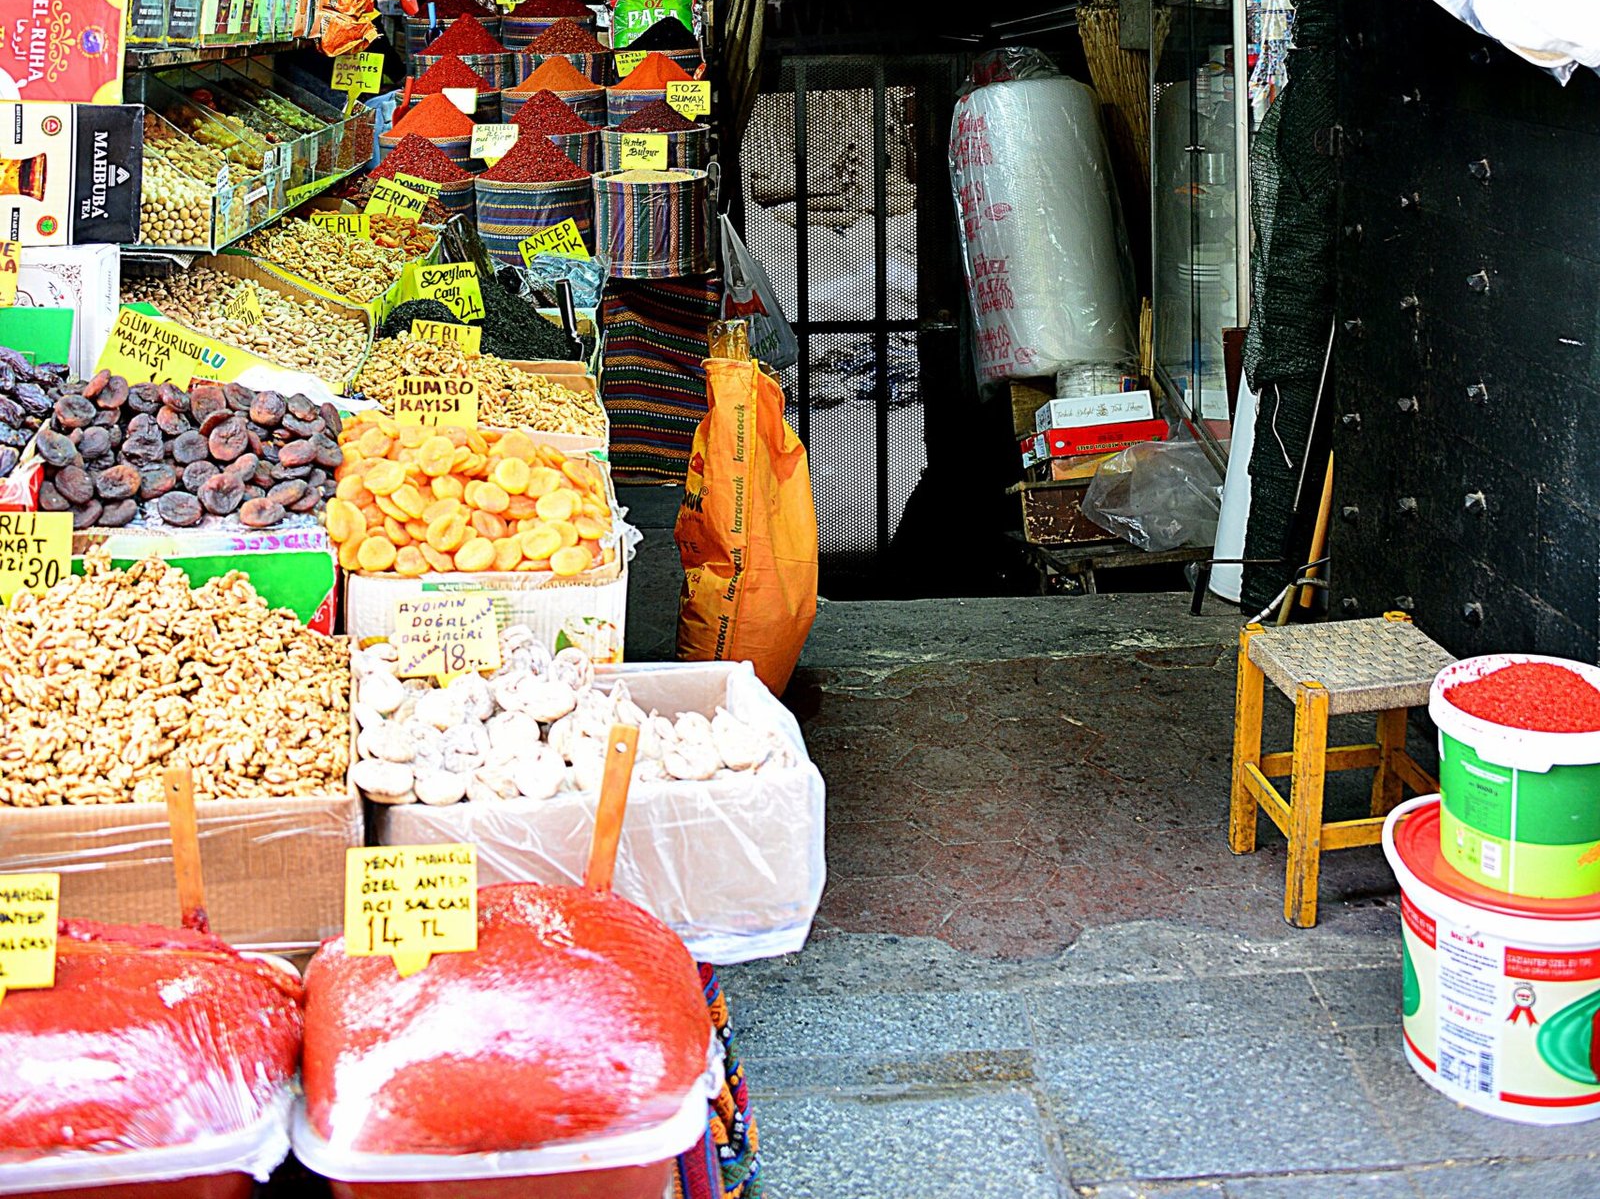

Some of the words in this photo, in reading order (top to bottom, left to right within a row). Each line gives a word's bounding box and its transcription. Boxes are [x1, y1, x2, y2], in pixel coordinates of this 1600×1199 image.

[335, 73, 353, 86] 25
[671, 84, 701, 93] TOZ
[669, 94, 705, 104] SUMAK
[91, 131, 108, 218] MAHBUBA
[81, 198, 90, 219] TEA
[312, 217, 362, 233] YERLİ
[524, 222, 571, 254] ANTEP
[455, 295, 481, 320] 24
[115, 327, 171, 360] MALATYA
[119, 311, 152, 335] GÜN
[153, 326, 203, 360] KURUSU
[119, 342, 164, 371] KAYISI
[398, 379, 474, 395] JUMBO
[400, 398, 460, 413] KAYISI
[732, 403, 745, 463] karacocuk
[731, 475, 744, 534] karacocuk
[399, 598, 466, 614] AYDININ
[412, 613, 468, 627] DOĞAL
[441, 643, 466, 675] 18
[364, 852, 404, 871] YENİ
[361, 875, 400, 894] ÖZEL
[363, 900, 392, 914] ACI
[367, 916, 404, 952] 14
[420, 918, 445, 937] TL
